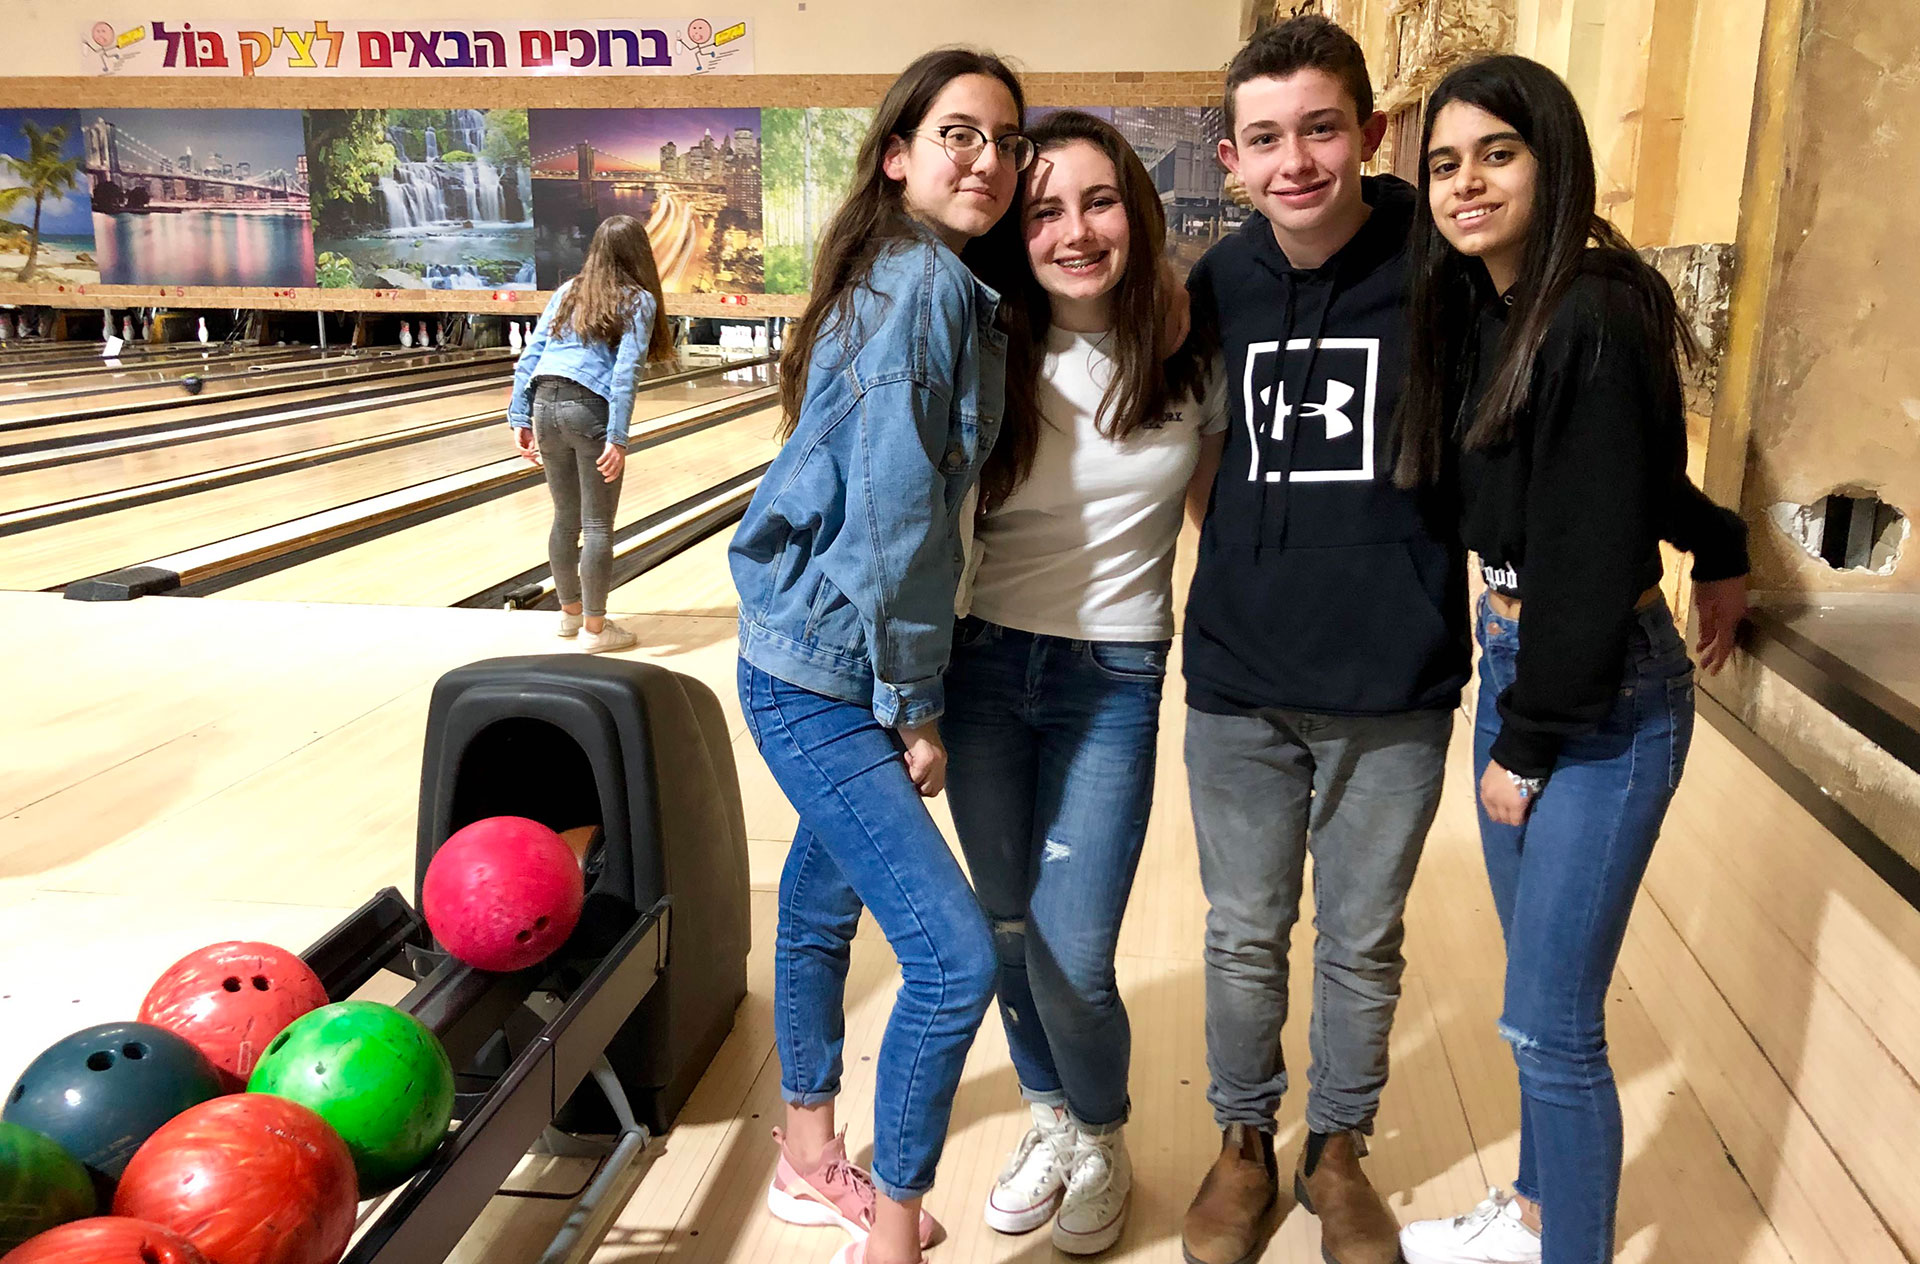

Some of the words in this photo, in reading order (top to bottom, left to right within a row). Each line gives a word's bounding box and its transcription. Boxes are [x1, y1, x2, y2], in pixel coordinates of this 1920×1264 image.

[357, 30, 508, 68] הבאים
[519, 29, 672, 68] ברוכים
[175, 286, 185, 298] 5
[287, 288, 297, 300] 6
[389, 290, 399, 301] 7
